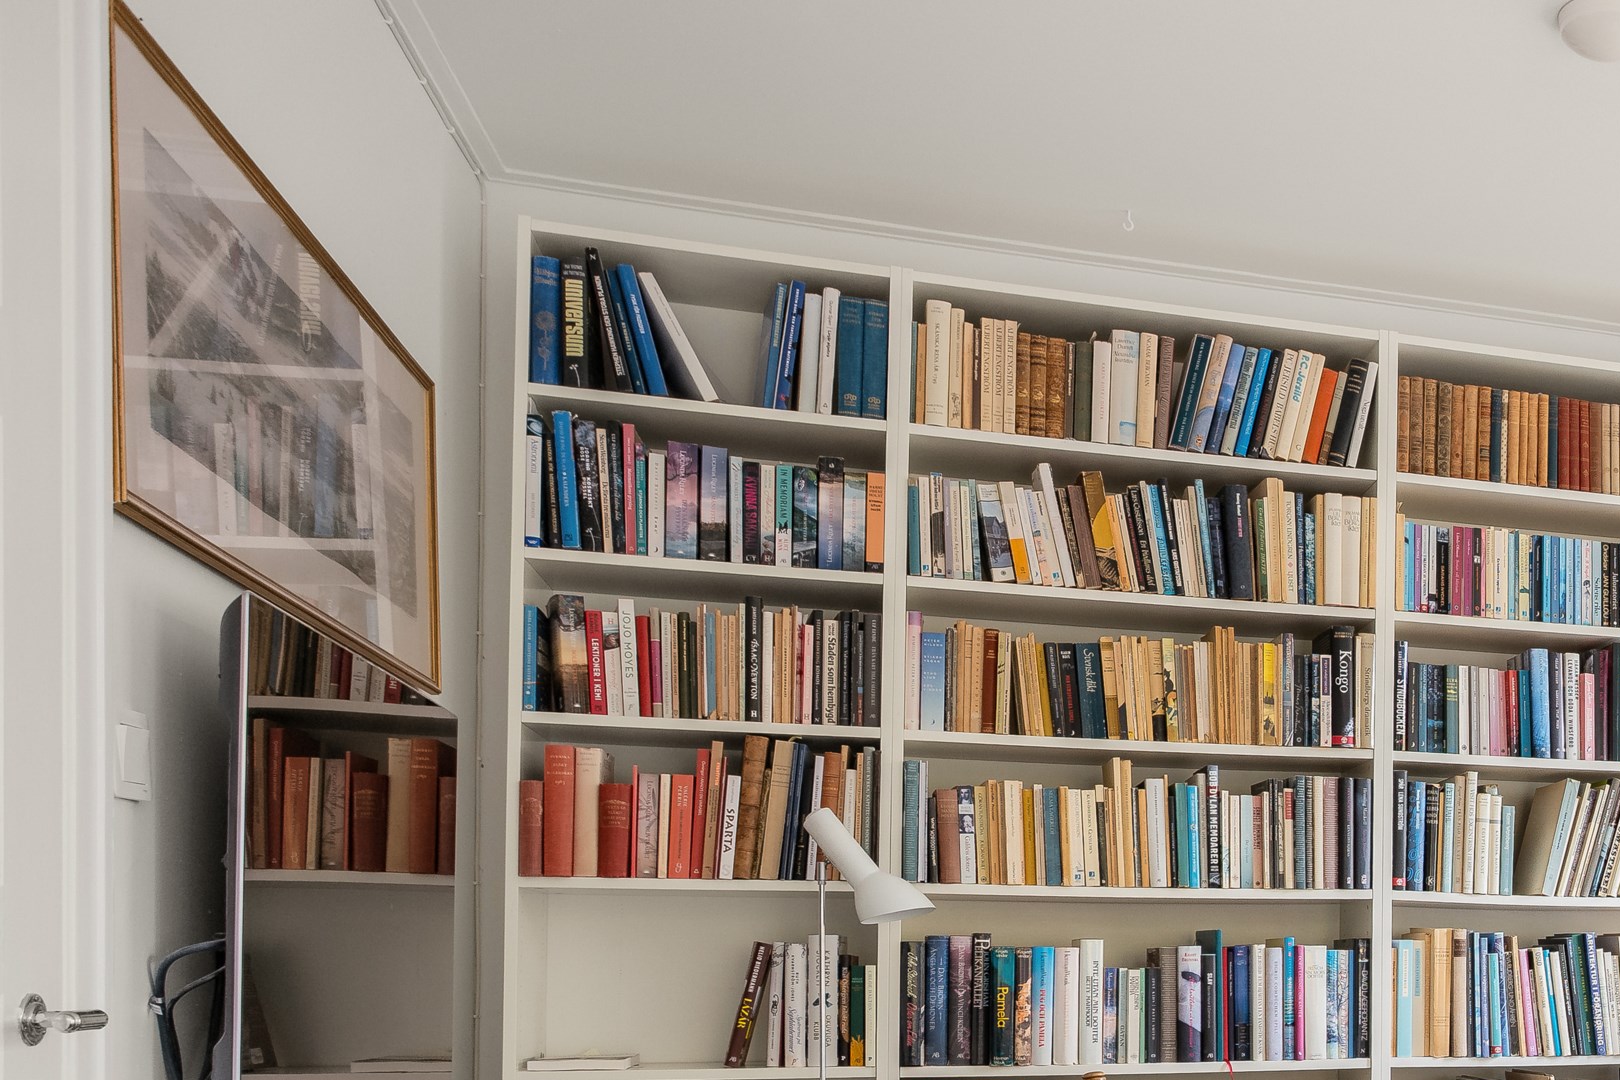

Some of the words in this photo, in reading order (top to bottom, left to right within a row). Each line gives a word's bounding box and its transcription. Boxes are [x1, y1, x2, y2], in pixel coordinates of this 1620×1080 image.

[565, 279, 584, 357] universum
[613, 352, 623, 376] STEPHEN
[983, 352, 991, 393] ENGSTRÖM
[1286, 353, 1295, 362] PC
[995, 354, 1003, 396] ENGSTRÖM
[1277, 364, 1292, 400] JERSILD
[1292, 370, 1306, 402] Jersild
[1270, 402, 1284, 433] BABELS
[530, 438, 538, 474] Astronomi
[780, 469, 787, 477] IN
[780, 479, 789, 518] MEMORIAM
[1133, 501, 1145, 535] Gustafsson
[1611, 572, 1619, 610] Juloratoriet
[622, 611, 631, 638] JOJO
[591, 638, 600, 677] LEKTIONER
[624, 642, 634, 679] MOYES
[828, 637, 836, 665] Staden
[1083, 648, 1094, 678] Svensk
[1087, 678, 1096, 692] dikt
[1335, 650, 1352, 693] Kongo
[594, 684, 602, 701] KEMI
[826, 686, 836, 723] hembygd
[1395, 679, 1405, 735] SYNDABOCKEN
[1209, 771, 1218, 786] BOB
[1209, 789, 1218, 815] DYLAN
[1397, 804, 1405, 830] SUNDSTRÖM
[723, 809, 735, 853] SPARTA
[1209, 817, 1218, 864] MEMOARER
[973, 937, 990, 1009] PELIKANFALLET
[1587, 934, 1598, 985] ARKITEKTUR
[748, 962, 762, 993] BIEDERMANN
[907, 968, 918, 998] Steinbeck
[929, 995, 937, 1030] DEMONER
[937, 985, 945, 1010] BROWN
[996, 986, 1009, 1028] Pamela
[1038, 989, 1046, 1003] PUG
[1038, 1004, 1046, 1019] OCH
[1592, 992, 1605, 1046] FÖRÄNDRING
